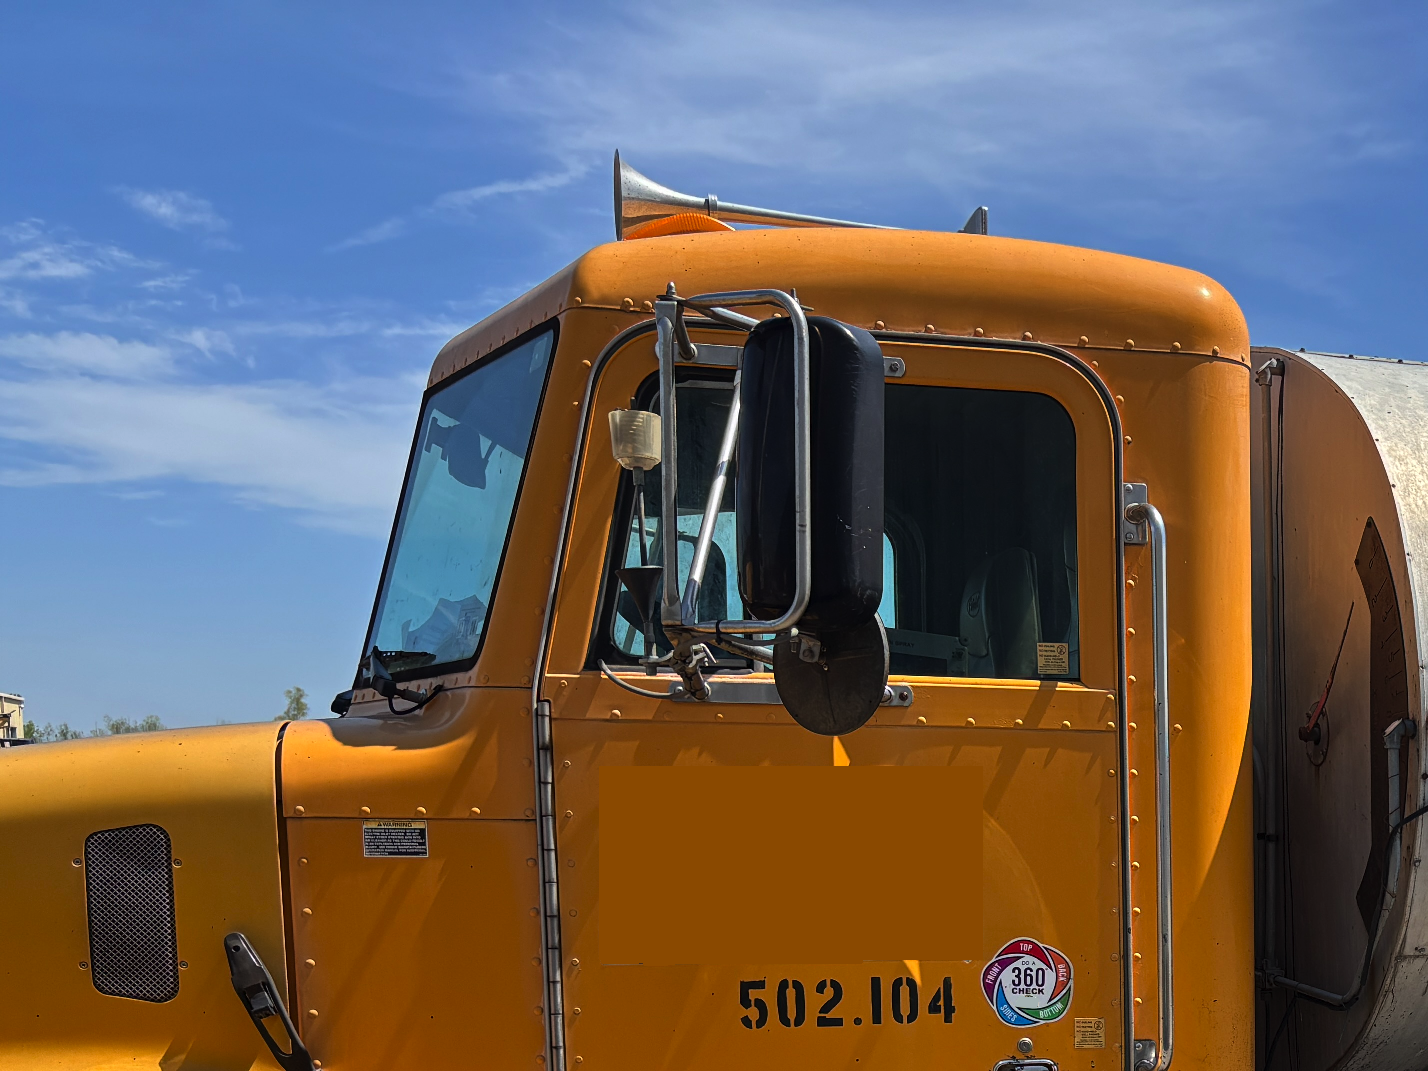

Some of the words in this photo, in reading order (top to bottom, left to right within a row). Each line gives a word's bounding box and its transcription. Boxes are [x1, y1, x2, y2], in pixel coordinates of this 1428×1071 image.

[1019, 942, 1033, 952] TOP
[985, 962, 1002, 985] FRONT
[1011, 966, 1046, 988] 360
[1057, 963, 1067, 982] BACK
[1011, 987, 1045, 995] CHECK
[739, 976, 956, 1030] 502.104
[1039, 1001, 1065, 1018] BOTTOM
[1000, 1004, 1018, 1022] SIDES
